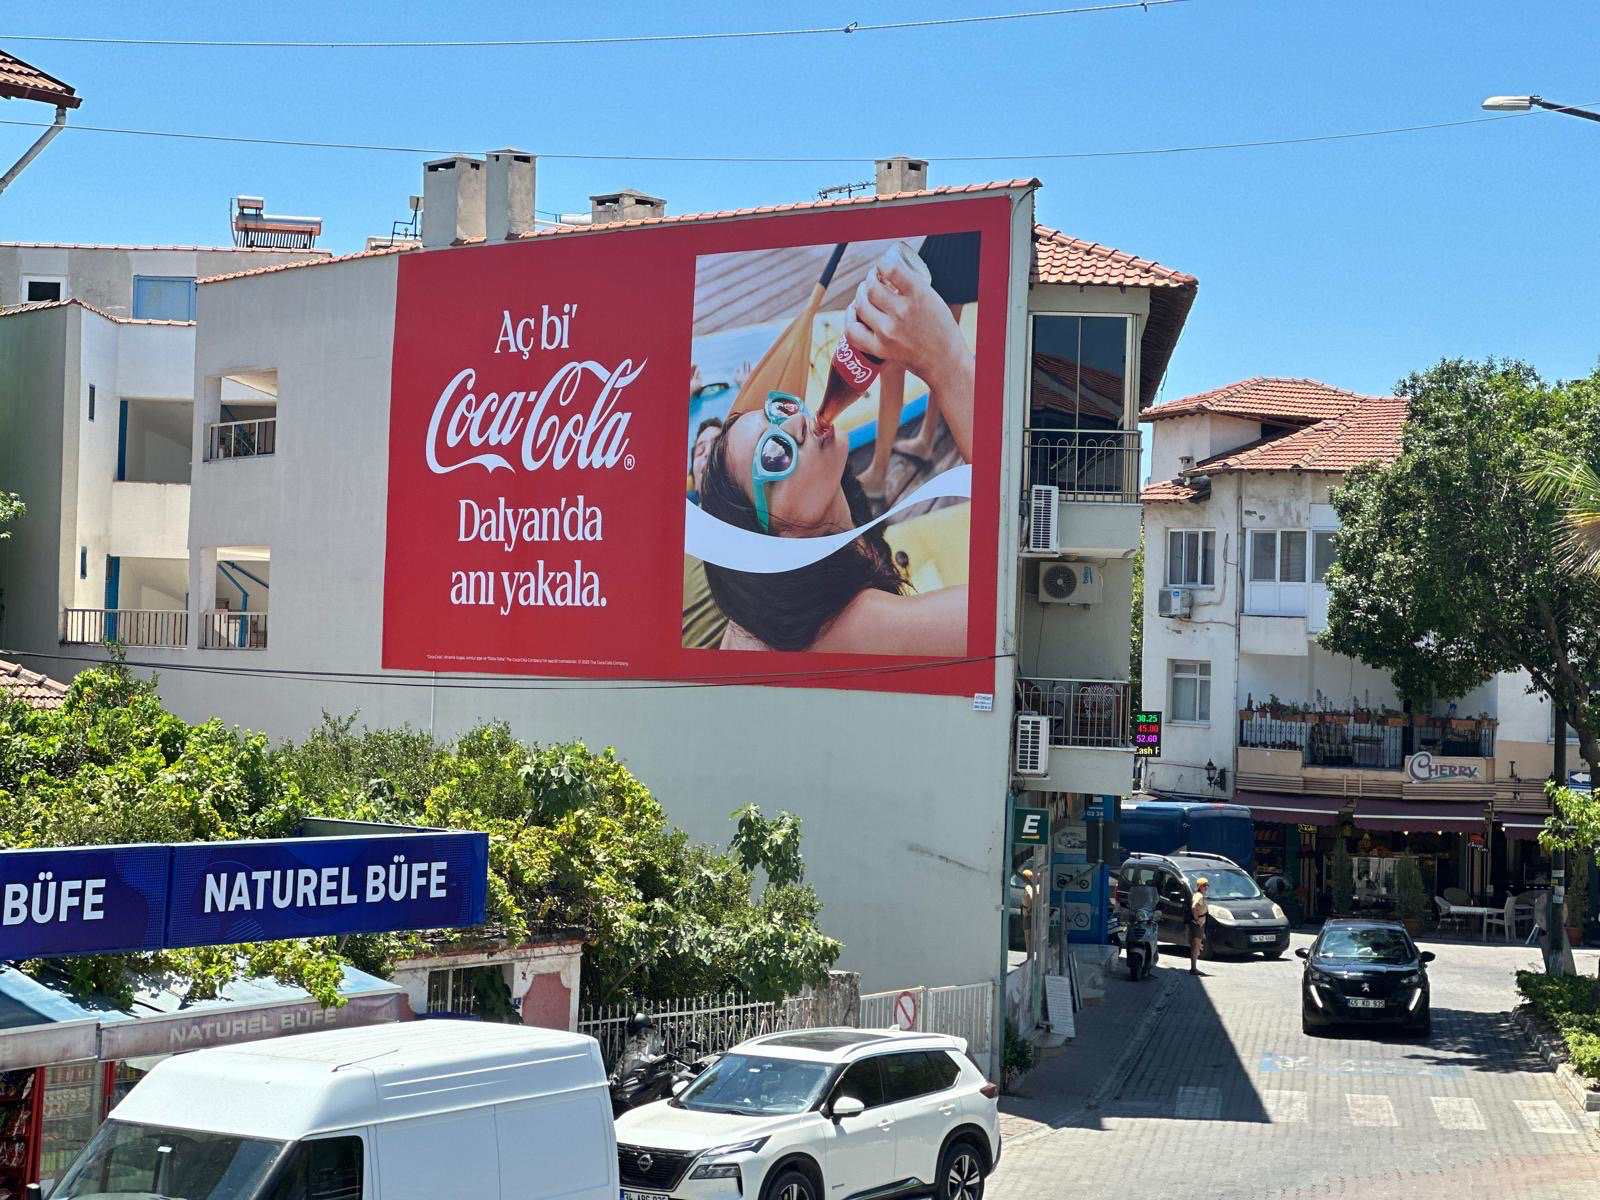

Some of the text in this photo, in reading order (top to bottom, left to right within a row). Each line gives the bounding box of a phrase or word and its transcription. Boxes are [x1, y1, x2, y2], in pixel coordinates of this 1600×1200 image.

[494, 303, 578, 360] Aç bi'
[426, 356, 649, 475] Coca-Cola
[457, 495, 603, 552] Dalyan'da
[450, 559, 607, 616] anı yakala.
[1136, 714, 1158, 723] 38.25
[1136, 734, 1158, 743] 52.60
[1138, 724, 1159, 733] 45.00
[1022, 814, 1041, 834] E
[2, 871, 106, 926] BÜFE
[204, 854, 448, 913] NATUREL BÜFE
[169, 1007, 337, 1044] NATUREL BÜFE
